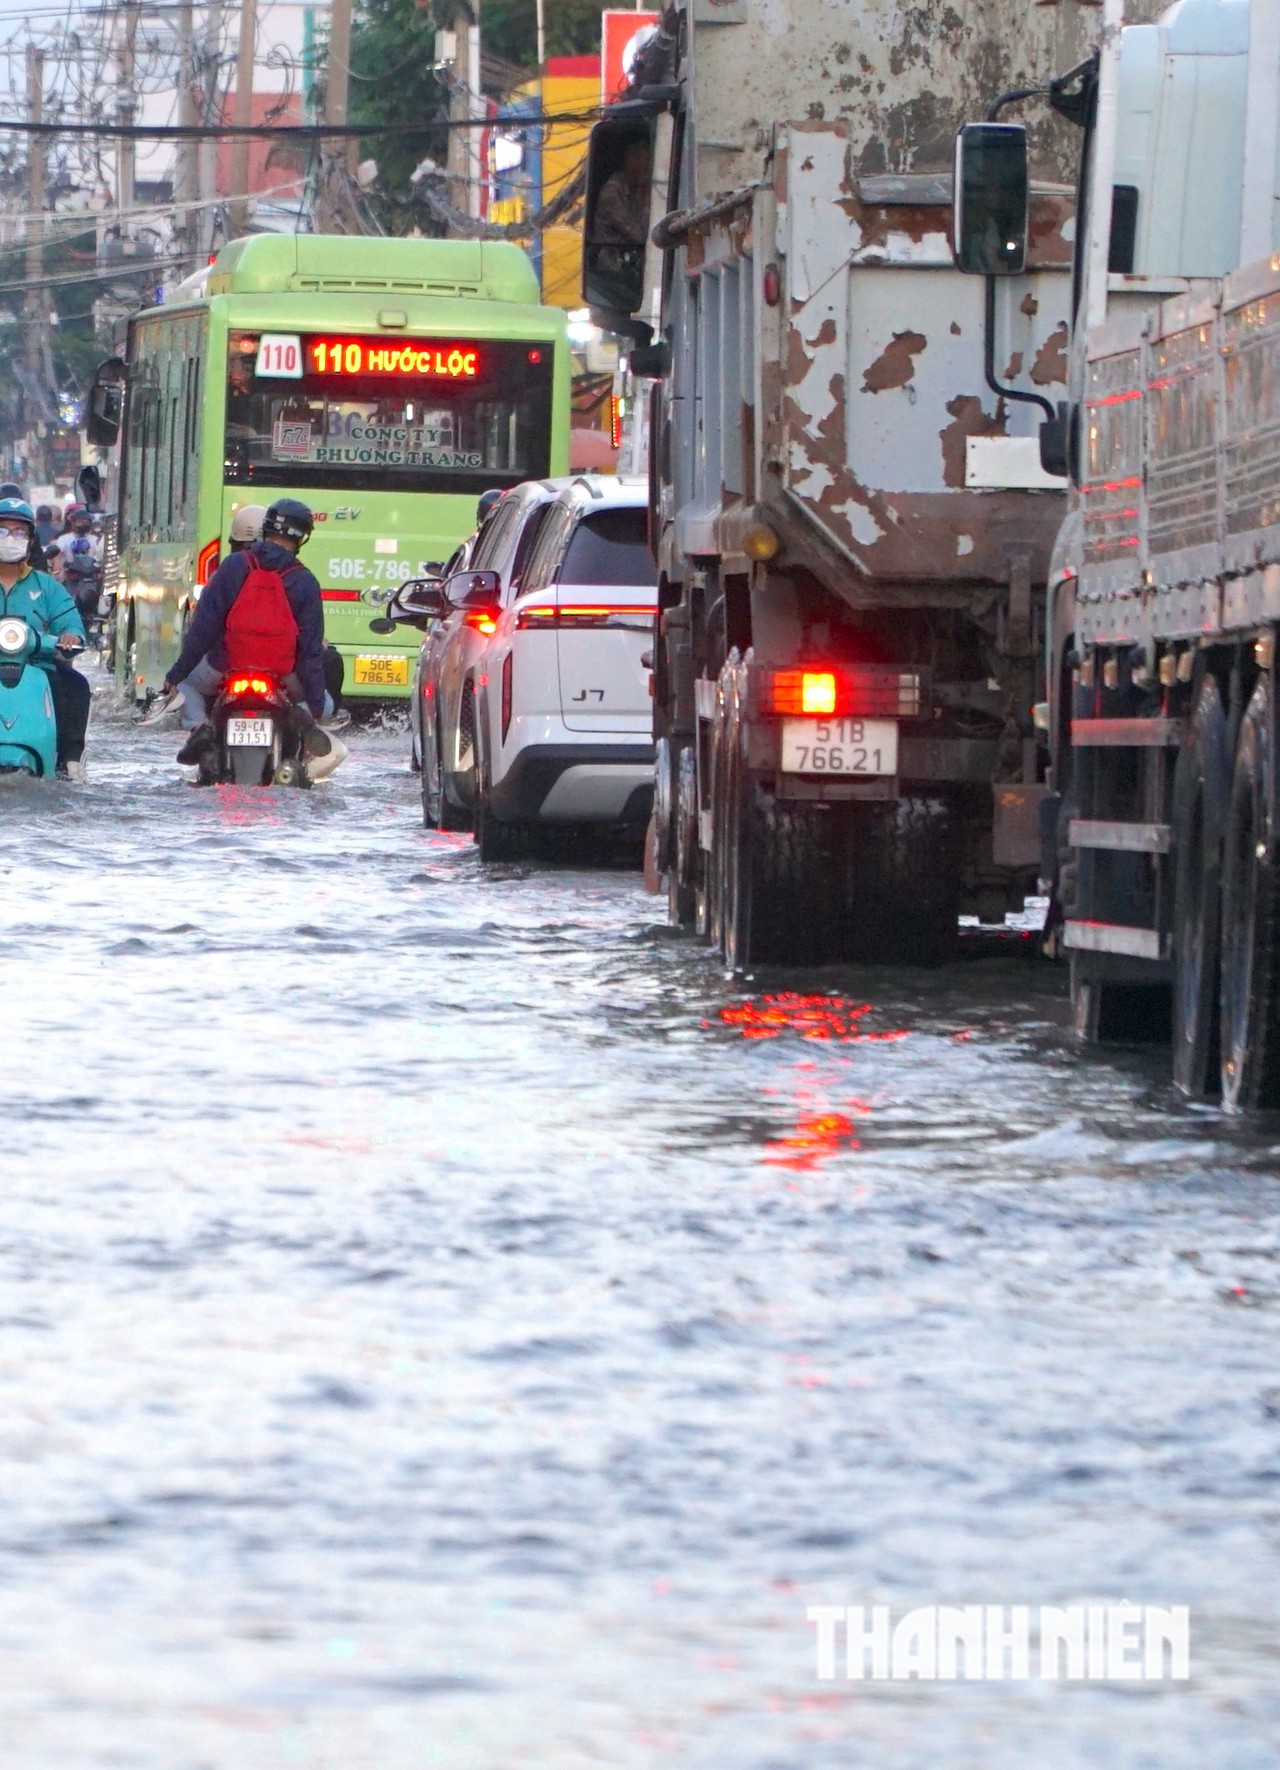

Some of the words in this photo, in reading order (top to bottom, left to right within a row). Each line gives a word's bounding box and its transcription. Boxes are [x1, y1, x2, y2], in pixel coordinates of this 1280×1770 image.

[262, 345, 296, 371] 110
[314, 342, 362, 373] 110
[369, 346, 431, 373] HƯỚC
[435, 349, 477, 377] LỘC
[351, 424, 407, 442] CÔNG
[413, 429, 440, 442] TY
[316, 447, 402, 464] PHƯƠNG
[407, 451, 482, 467] TRANG
[328, 558, 427, 580] 50E-786.5
[370, 660, 393, 671] 50E
[361, 671, 402, 683] 786.54
[572, 689, 605, 702] J7
[232, 733, 268, 744] 131.51
[816, 720, 864, 743] 51B
[795, 746, 882, 772] 766.21
